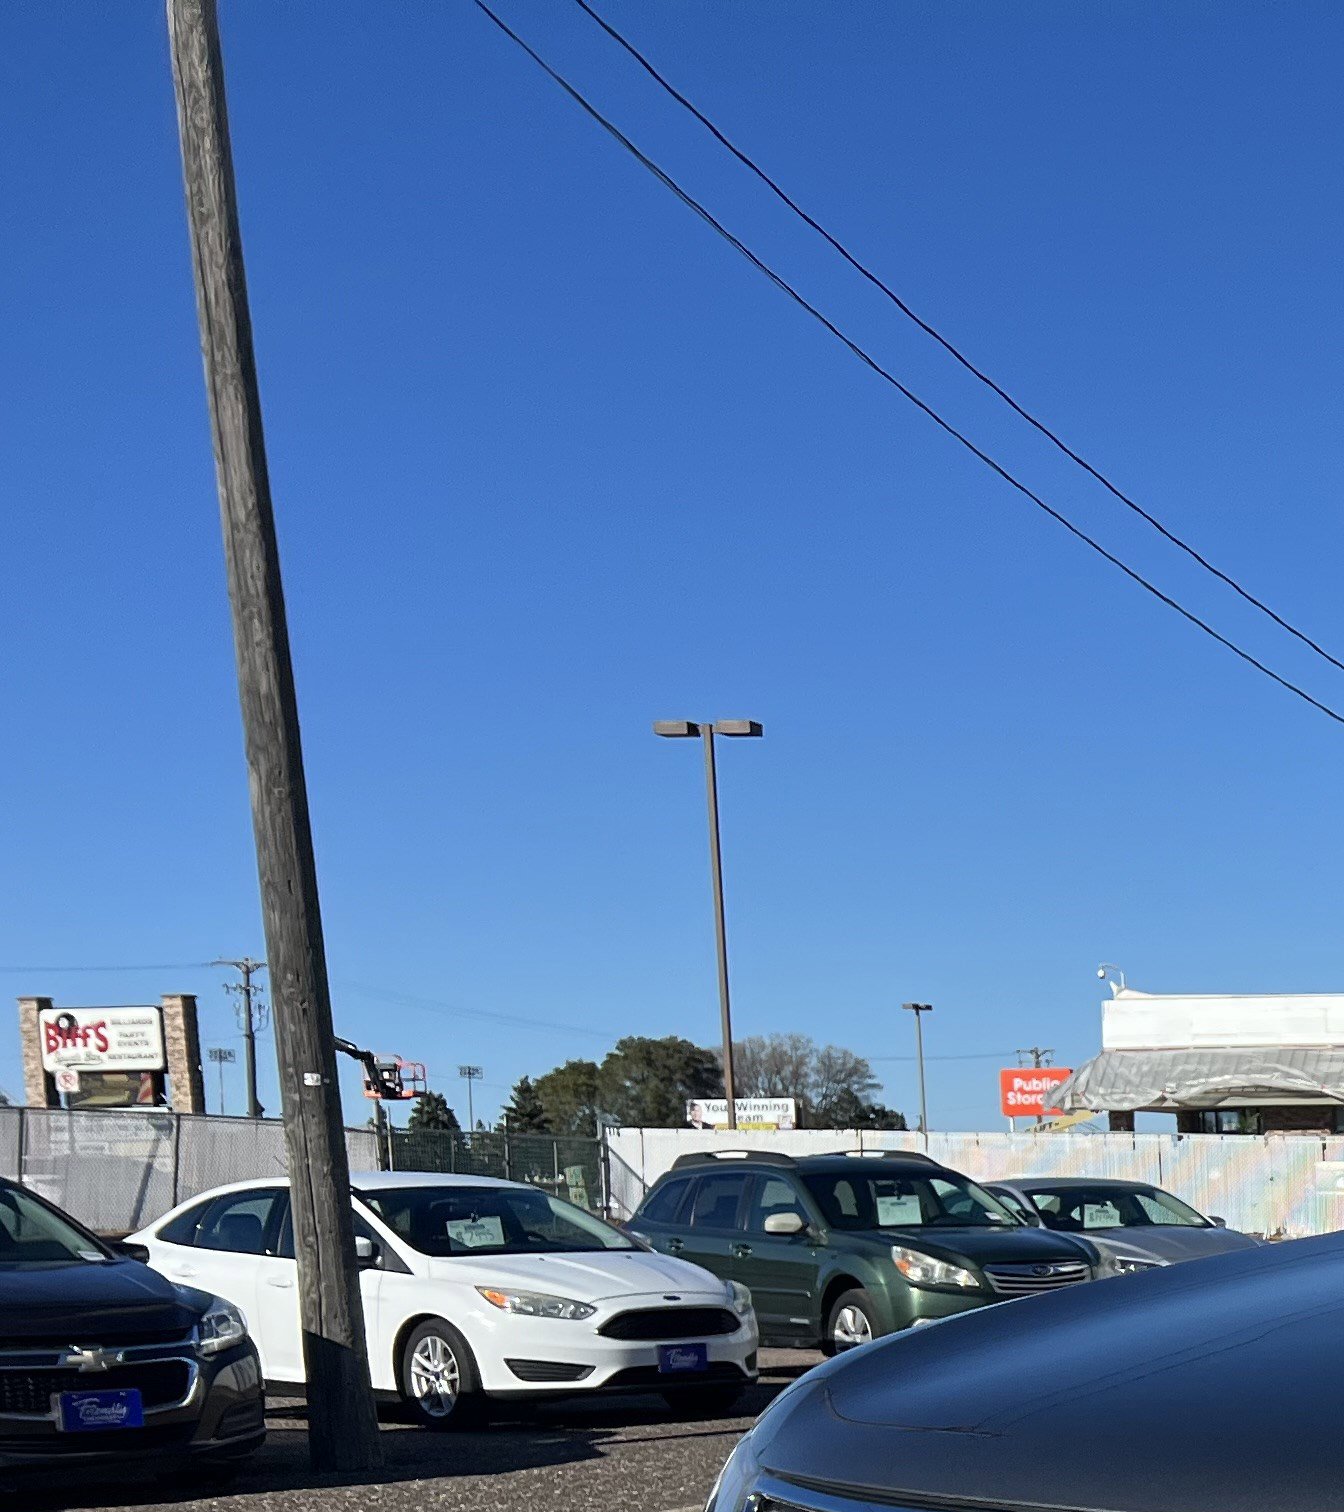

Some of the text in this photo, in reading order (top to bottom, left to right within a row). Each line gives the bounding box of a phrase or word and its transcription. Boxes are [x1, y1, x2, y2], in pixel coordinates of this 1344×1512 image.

[1007, 1092, 1043, 1105] Stor
[705, 1101, 789, 1113] You Winning
[737, 1114, 763, 1122] eam
